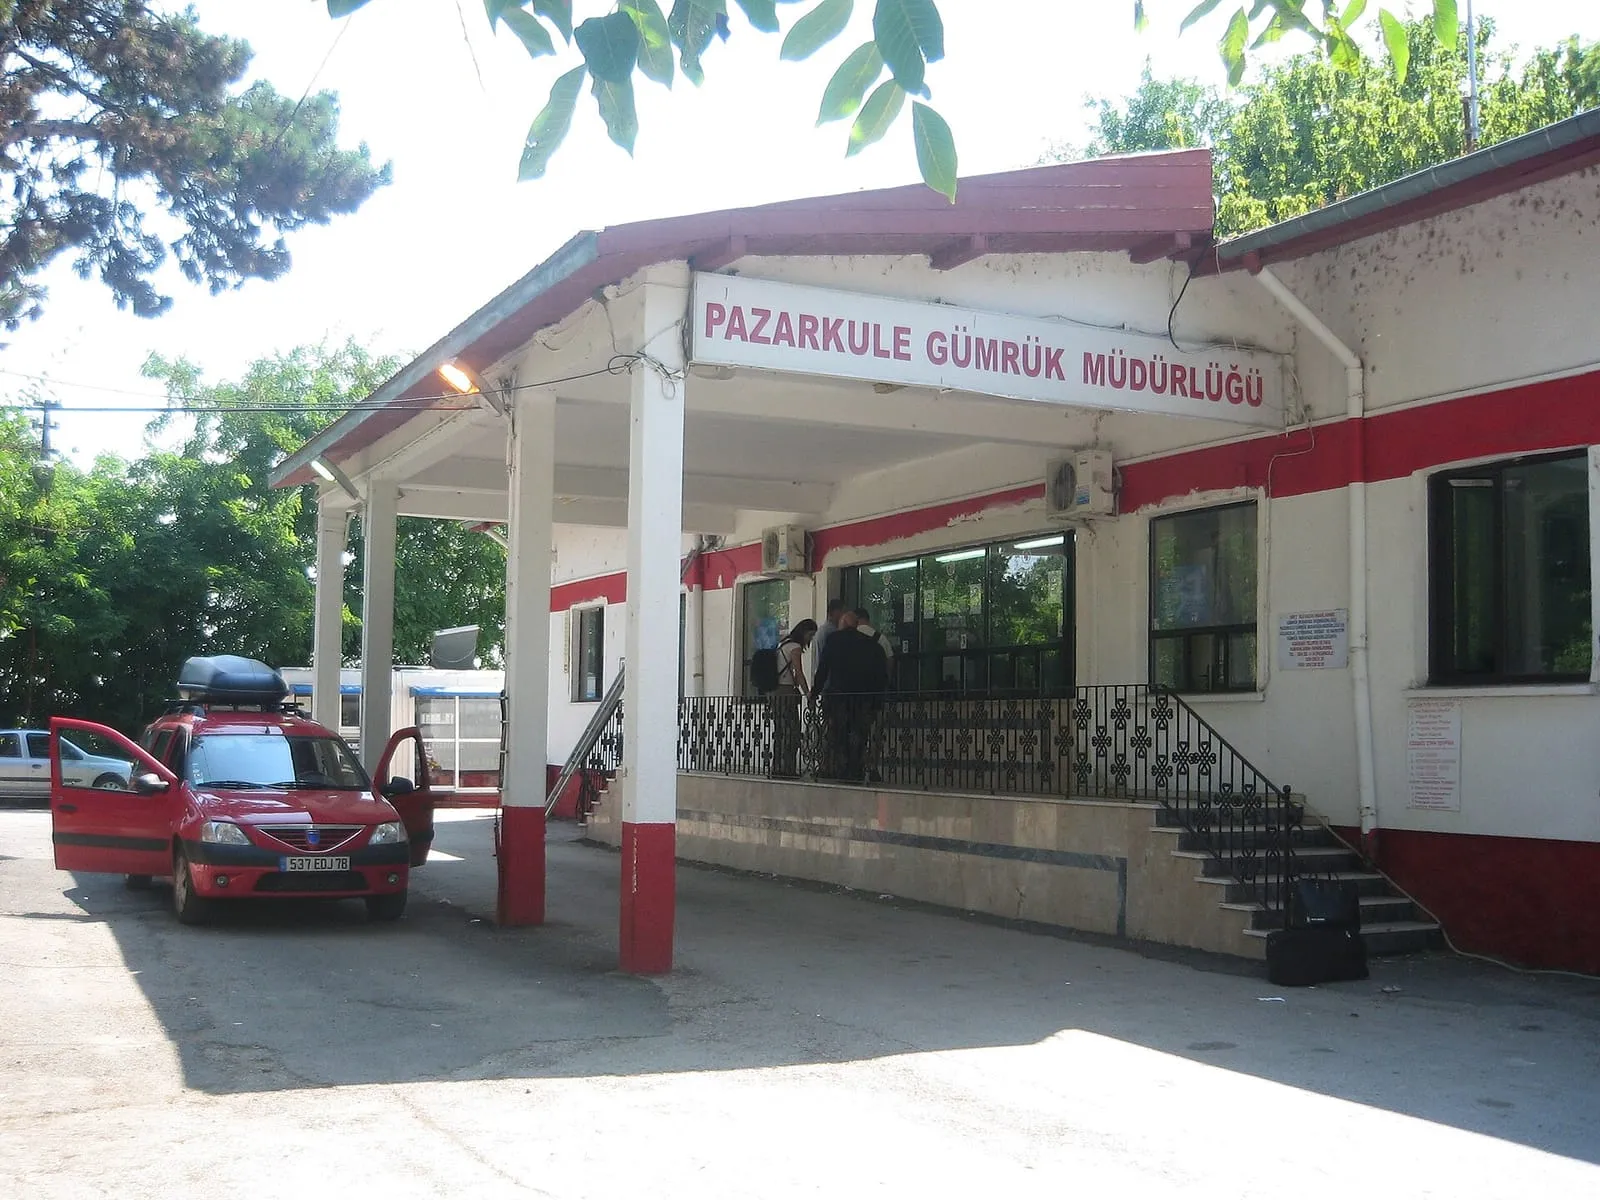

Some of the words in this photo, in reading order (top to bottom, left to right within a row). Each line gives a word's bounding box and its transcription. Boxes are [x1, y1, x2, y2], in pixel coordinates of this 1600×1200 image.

[705, 302, 912, 361] PAZARKULE
[926, 326, 1066, 381] GÜMRÜK
[1082, 348, 1264, 408] MÜDÜRLÜĞÜ
[290, 858, 311, 870] 537
[335, 858, 348, 869] 78
